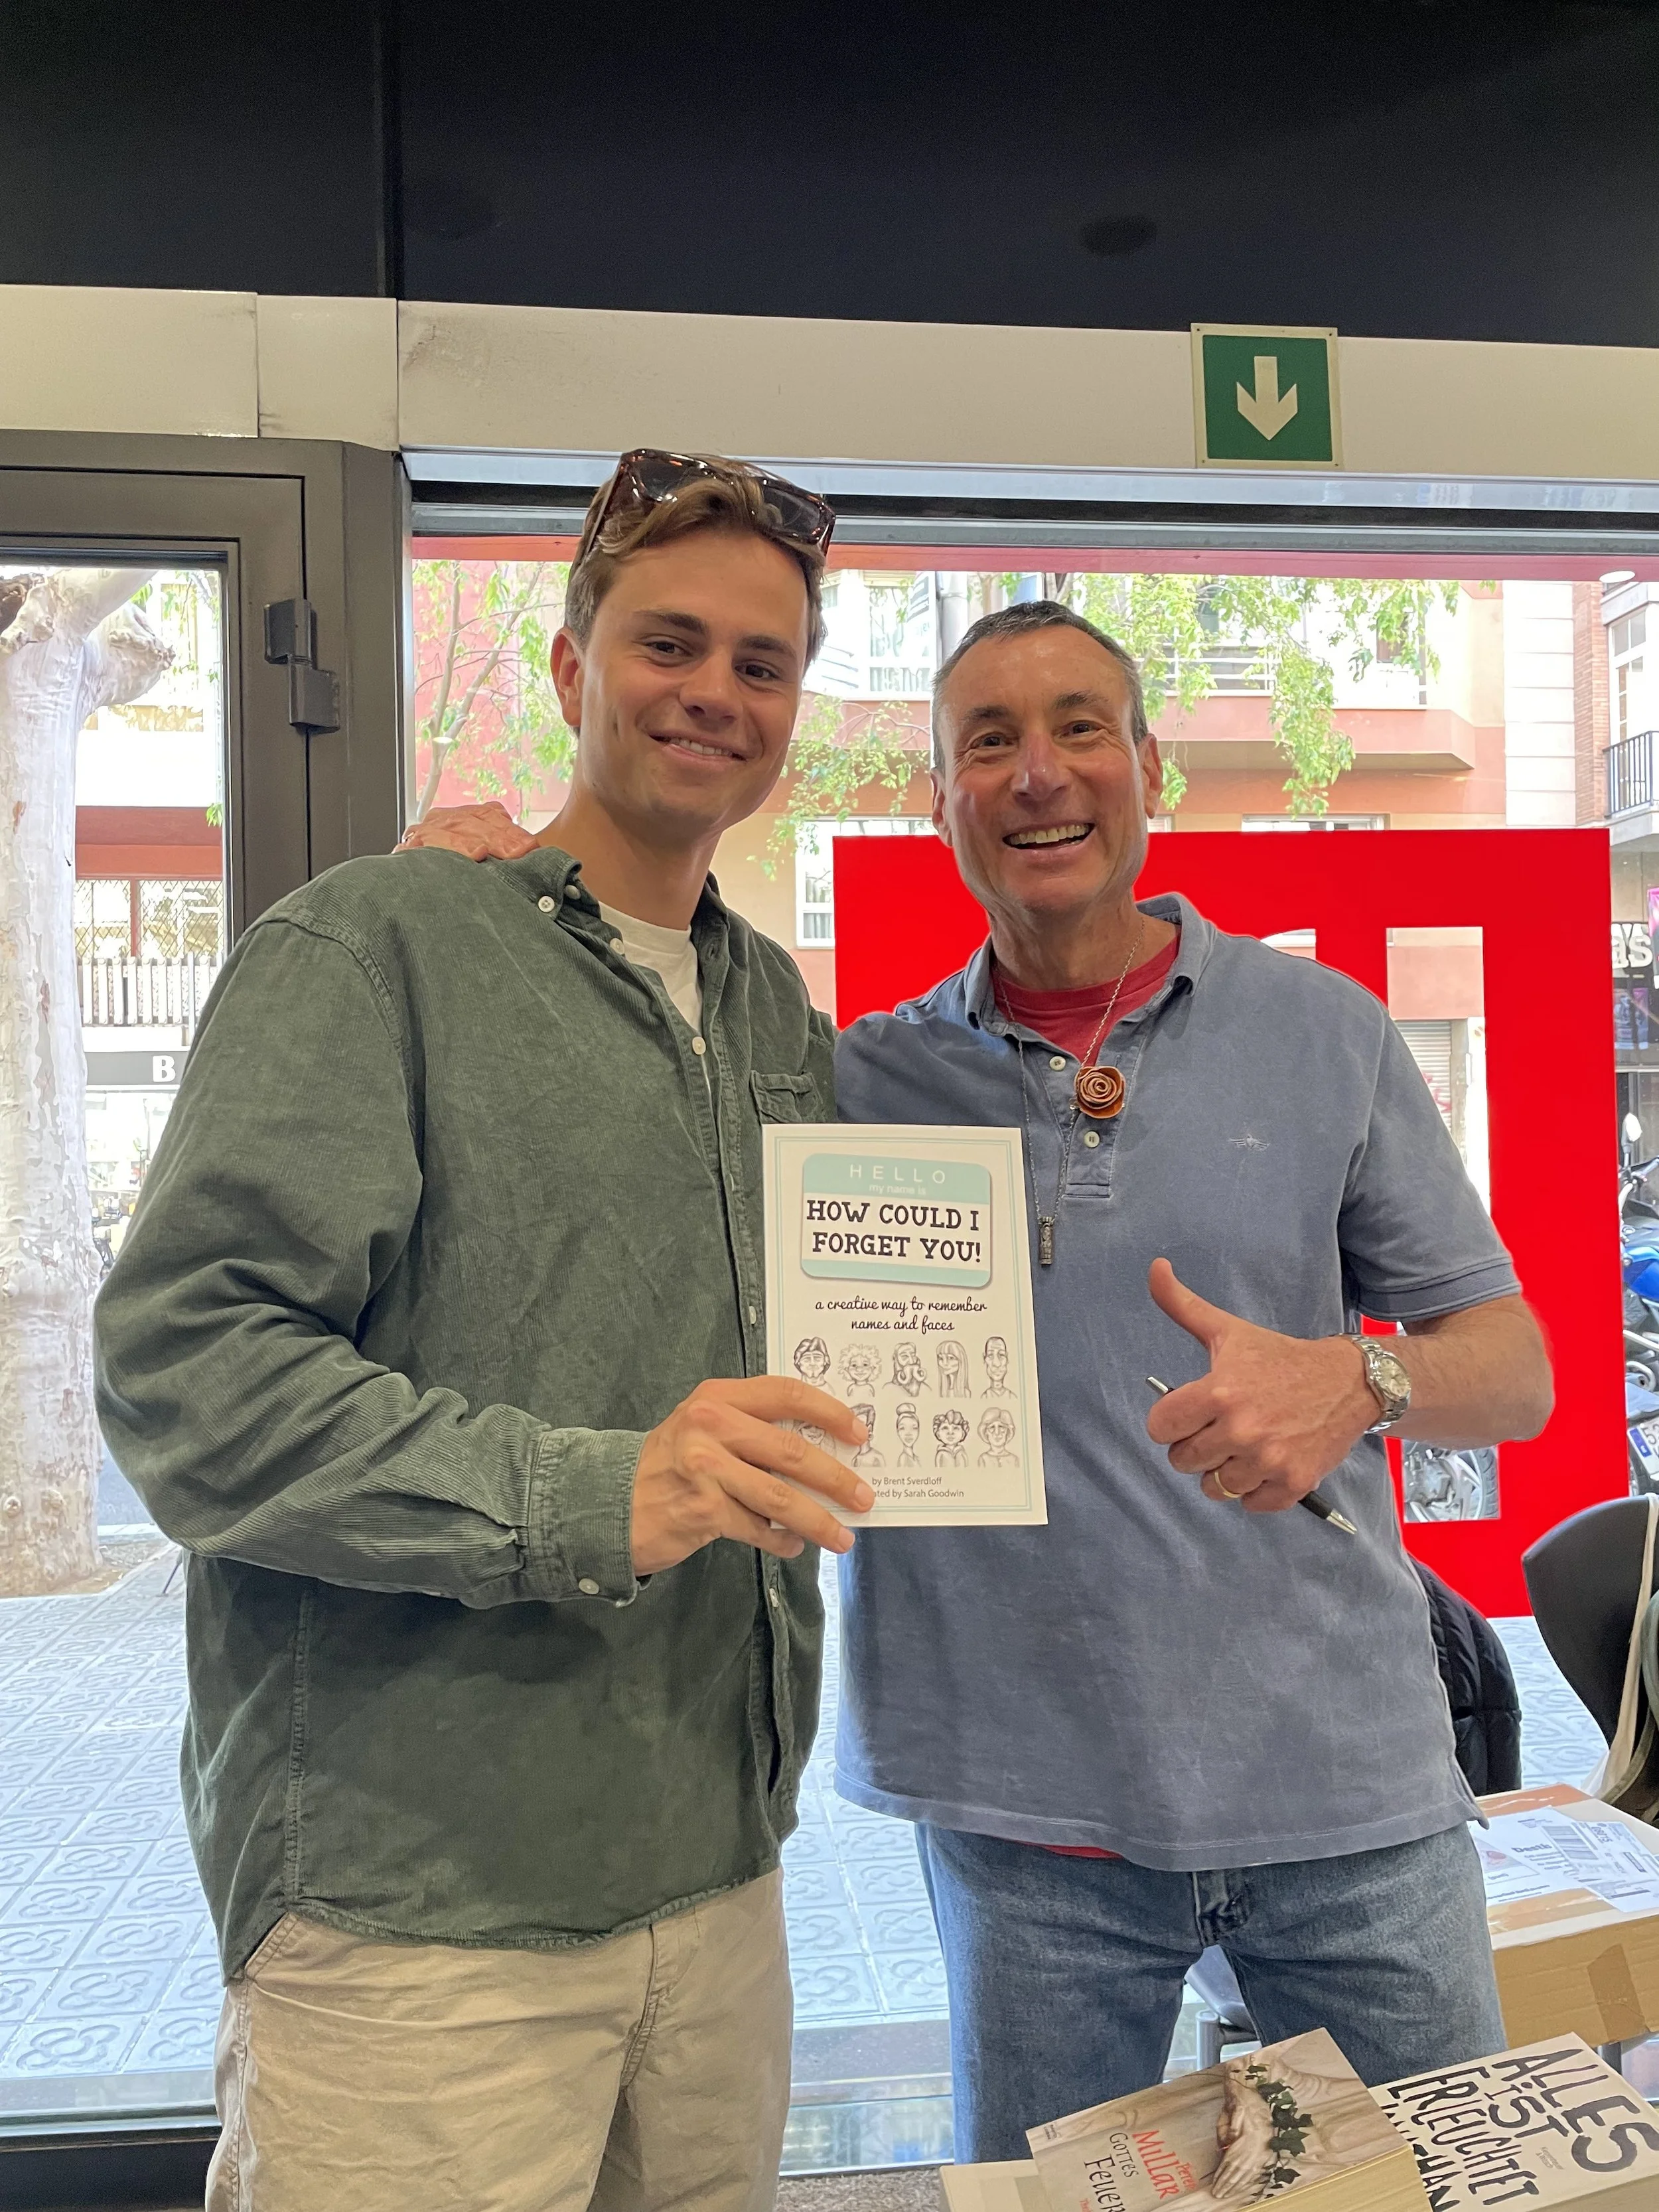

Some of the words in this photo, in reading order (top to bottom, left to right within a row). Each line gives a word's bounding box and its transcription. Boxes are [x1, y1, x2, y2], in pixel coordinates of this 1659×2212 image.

[849, 1164, 946, 1184] HELLO
[869, 1184, 884, 1193] my
[887, 1185, 915, 1194] name
[918, 1185, 926, 1195] is
[806, 1200, 870, 1222] HOW
[879, 1204, 962, 1229] COULD
[970, 1210, 979, 1230] I
[812, 1232, 910, 1257] FORGET
[920, 1238, 981, 1263] YOU!
[815, 1301, 824, 1310] a
[828, 1295, 879, 1310] creative
[881, 1301, 908, 1317] way
[910, 1296, 926, 1311] to
[928, 1296, 987, 1311] remember
[851, 1320, 891, 1329] names
[894, 1315, 918, 1329] and
[922, 1315, 955, 1335] faces
[872, 1477, 882, 1487] by
[907, 1477, 942, 1485] Sverdloff
[892, 1489, 902, 1499] by
[904, 1489, 926, 1498] Sarah
[928, 1489, 964, 1498] Goodwin
[1492, 2049, 1659, 2172] ALLES
[1388, 2066, 1540, 2206] ERLEUCHTET
